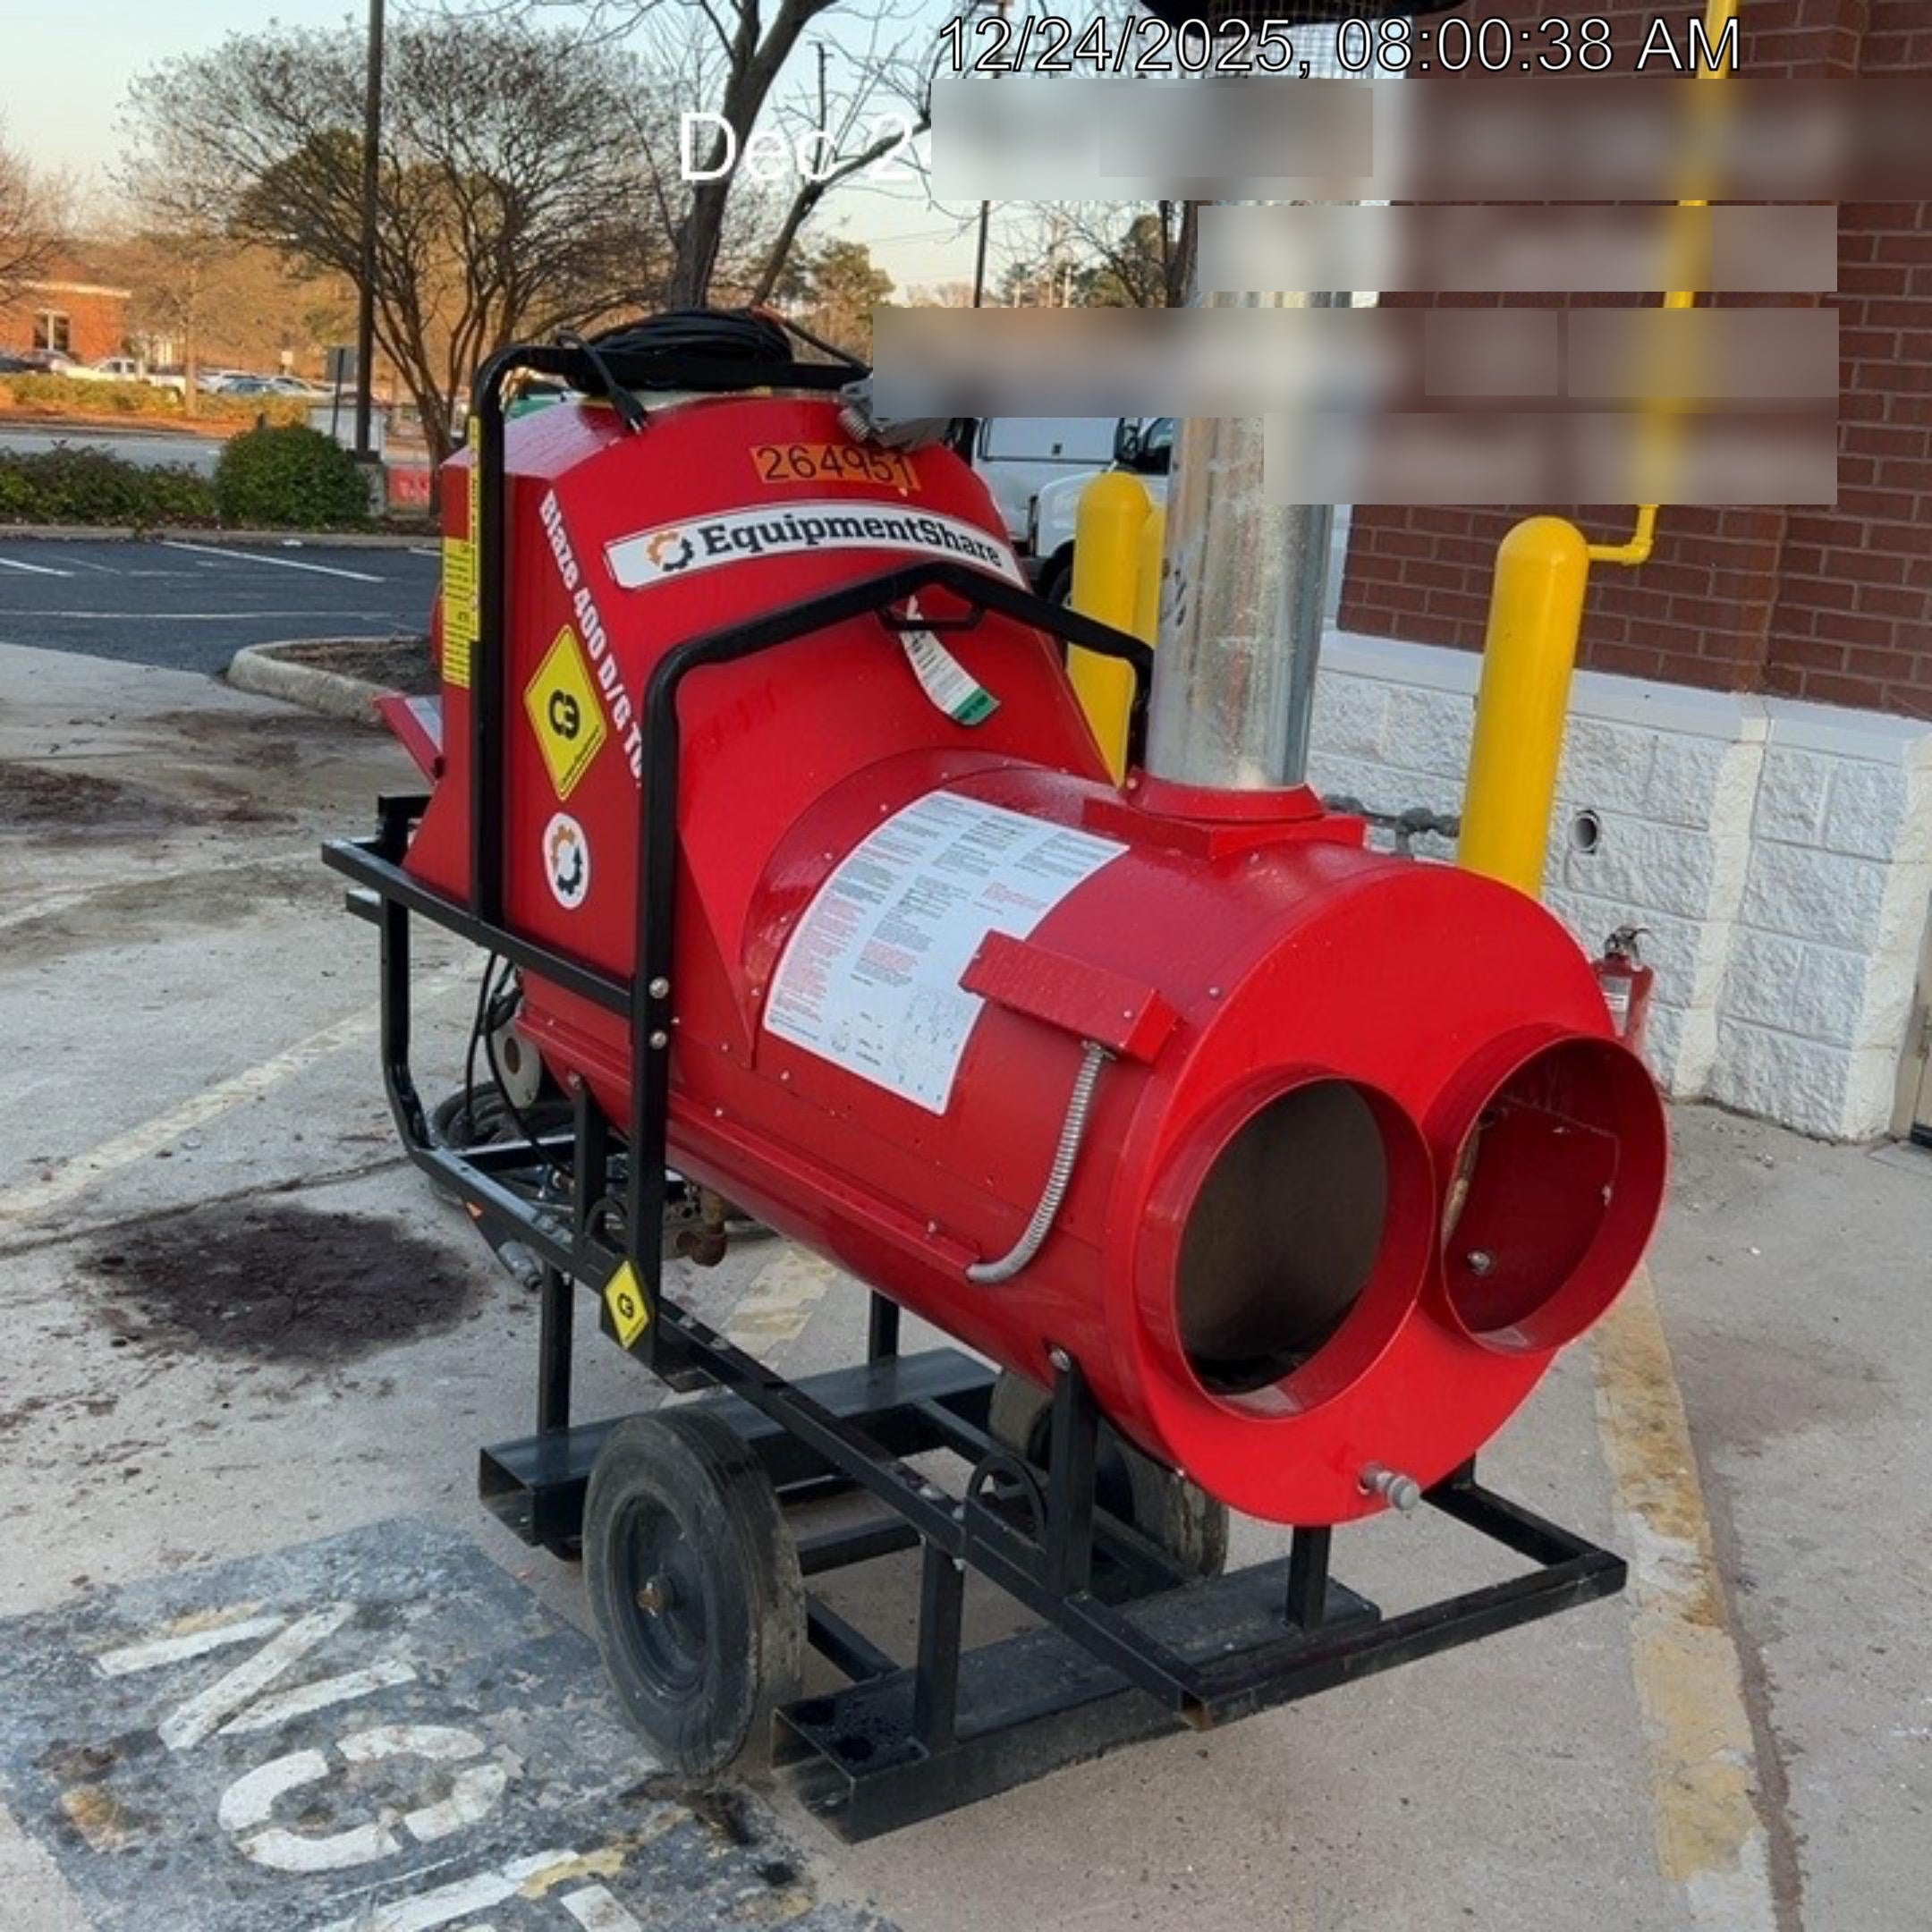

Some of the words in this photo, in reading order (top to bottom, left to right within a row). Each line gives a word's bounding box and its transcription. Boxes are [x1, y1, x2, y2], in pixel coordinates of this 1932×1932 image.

[756, 444, 915, 487] 264951
[699, 513, 1003, 567] EquipmentShare
[539, 488, 579, 590] Blaze
[573, 586, 608, 661] 400
